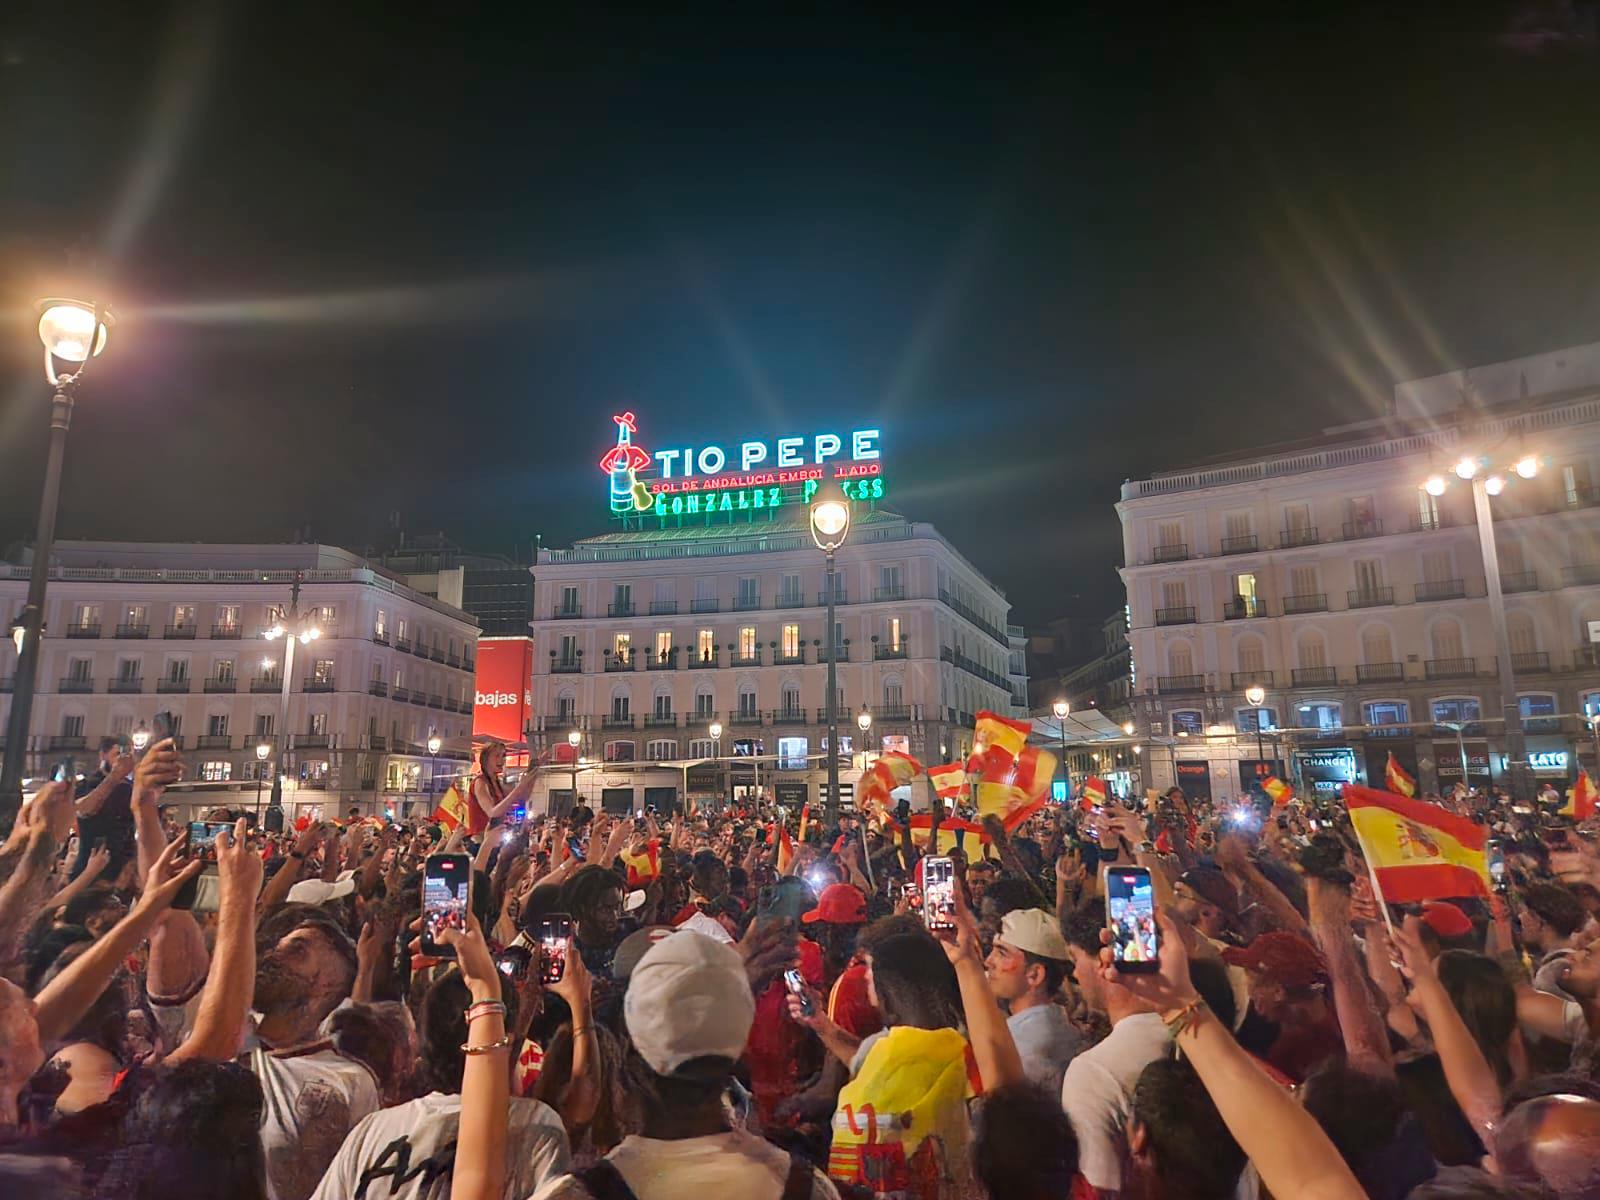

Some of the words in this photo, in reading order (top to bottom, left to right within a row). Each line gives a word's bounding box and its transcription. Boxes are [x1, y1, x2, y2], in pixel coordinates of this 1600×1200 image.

[655, 446, 725, 479] TIO
[742, 430, 880, 471] PEPE
[651, 483, 678, 494] SOL
[681, 480, 699, 491] DE
[703, 473, 775, 490] ANDALUCIA
[655, 487, 780, 516] GONZALEZ
[474, 690, 518, 709] bajas
[1303, 758, 1346, 767] CHANGE
[1529, 752, 1567, 767] LATO
